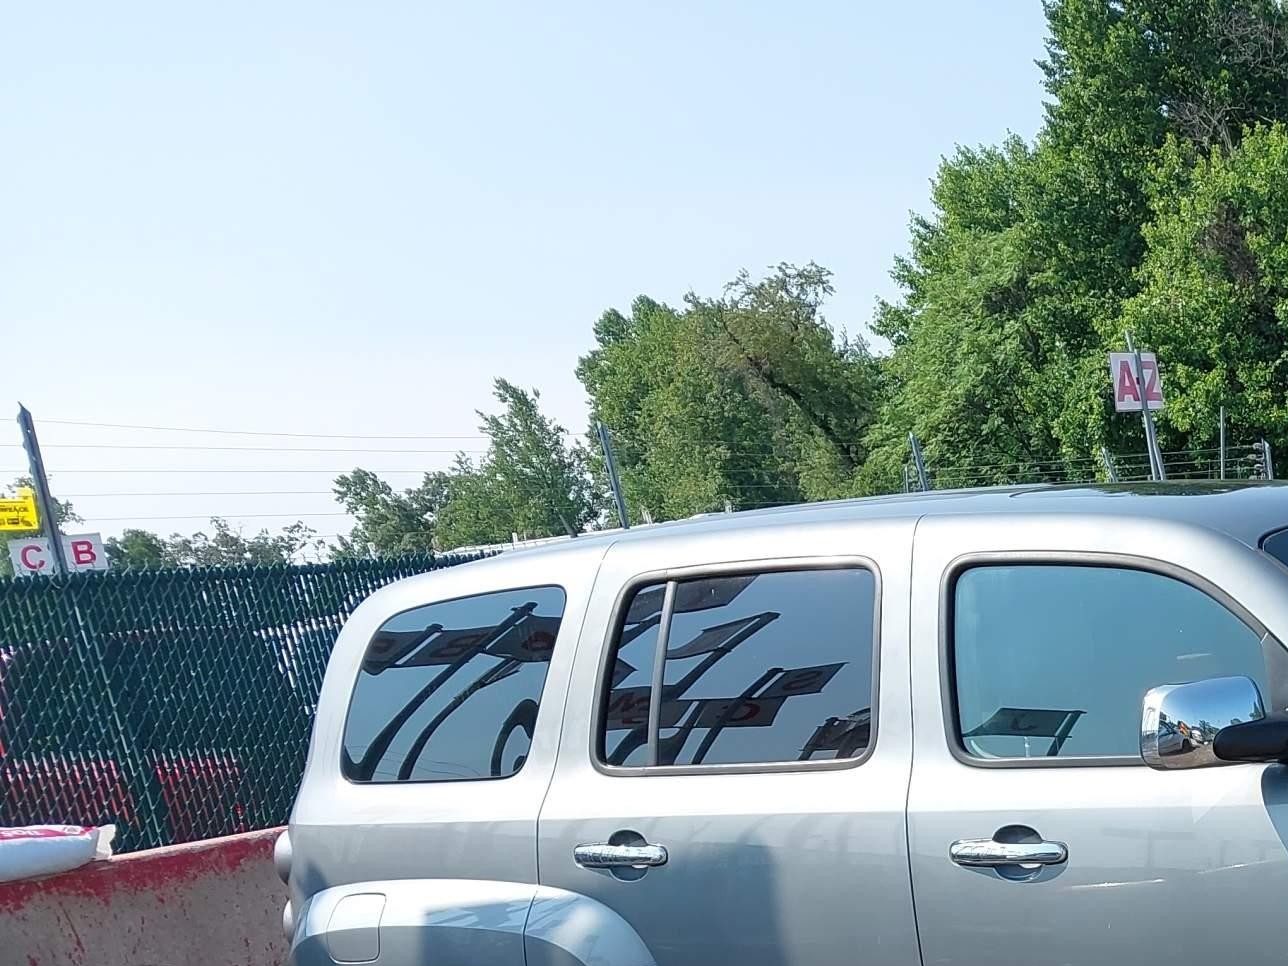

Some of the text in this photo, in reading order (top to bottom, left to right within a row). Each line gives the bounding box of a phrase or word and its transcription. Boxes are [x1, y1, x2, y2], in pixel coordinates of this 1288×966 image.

[1118, 360, 1163, 402] A2
[21, 544, 45, 569] C
[71, 540, 97, 565] B
